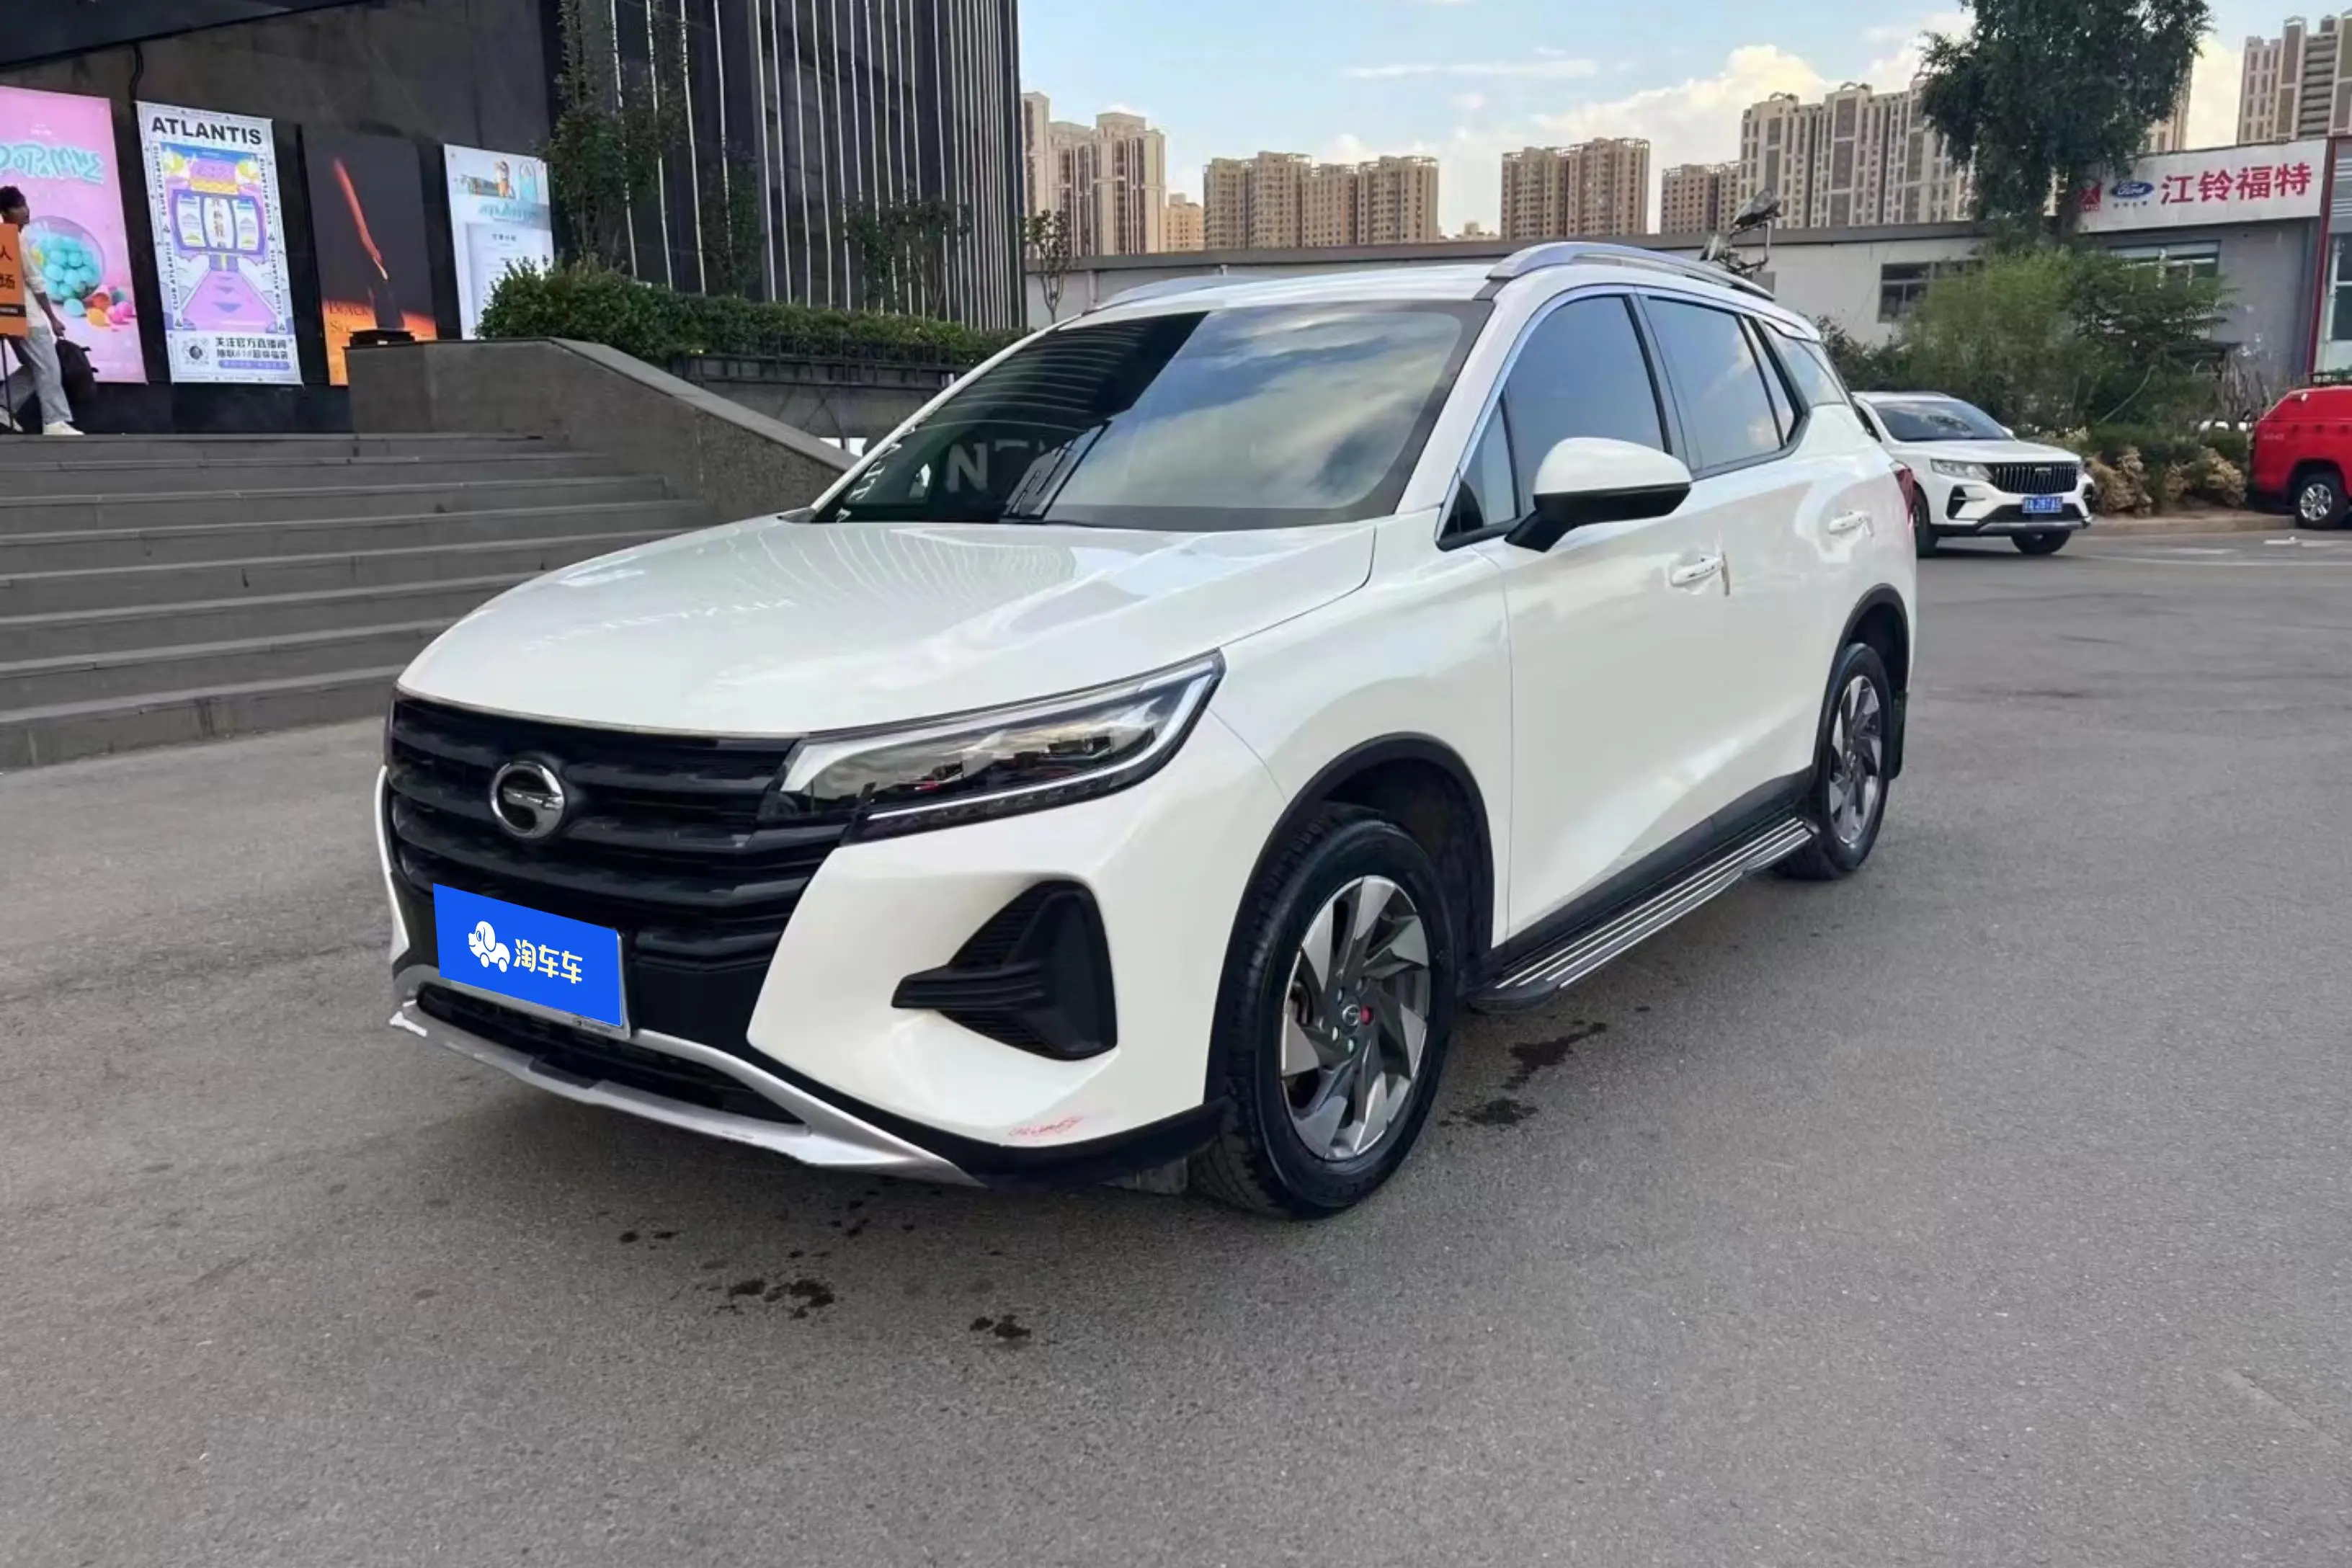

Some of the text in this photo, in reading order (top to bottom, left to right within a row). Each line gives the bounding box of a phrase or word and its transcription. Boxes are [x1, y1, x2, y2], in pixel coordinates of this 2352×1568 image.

[152, 117, 262, 144] ATLANTIS
[2161, 162, 2312, 205] 江铃福特
